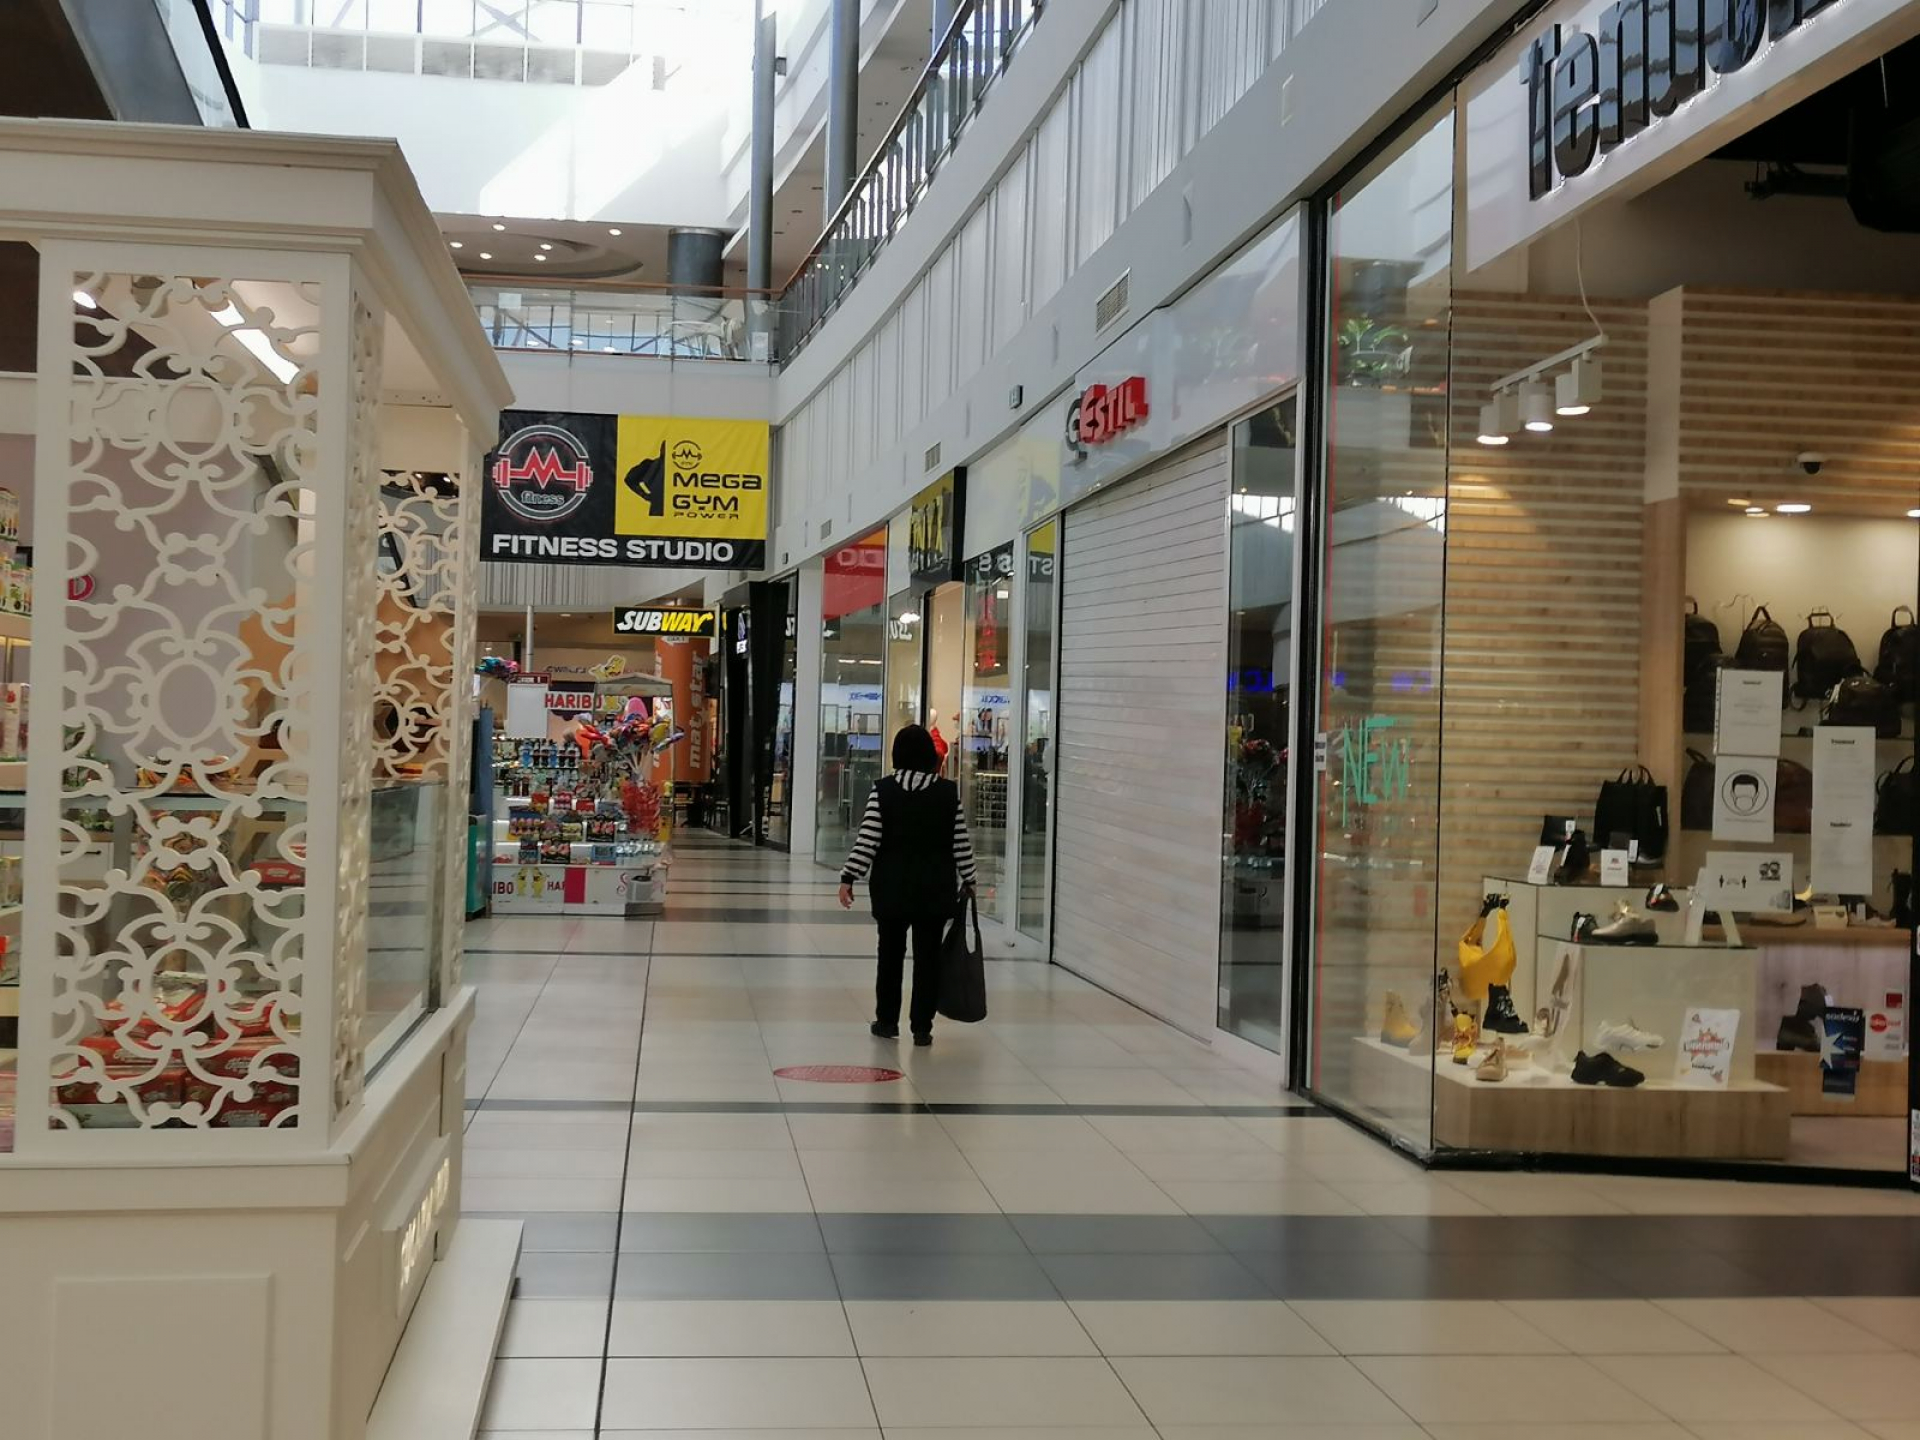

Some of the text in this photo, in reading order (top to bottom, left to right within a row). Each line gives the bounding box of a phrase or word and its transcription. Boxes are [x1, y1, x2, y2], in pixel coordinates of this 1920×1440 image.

[492, 534, 734, 562] FITNESS STUDIO
[616, 610, 714, 632] SUBWAY
[544, 693, 602, 709] HARIBO
[1343, 717, 1412, 827] NEW
